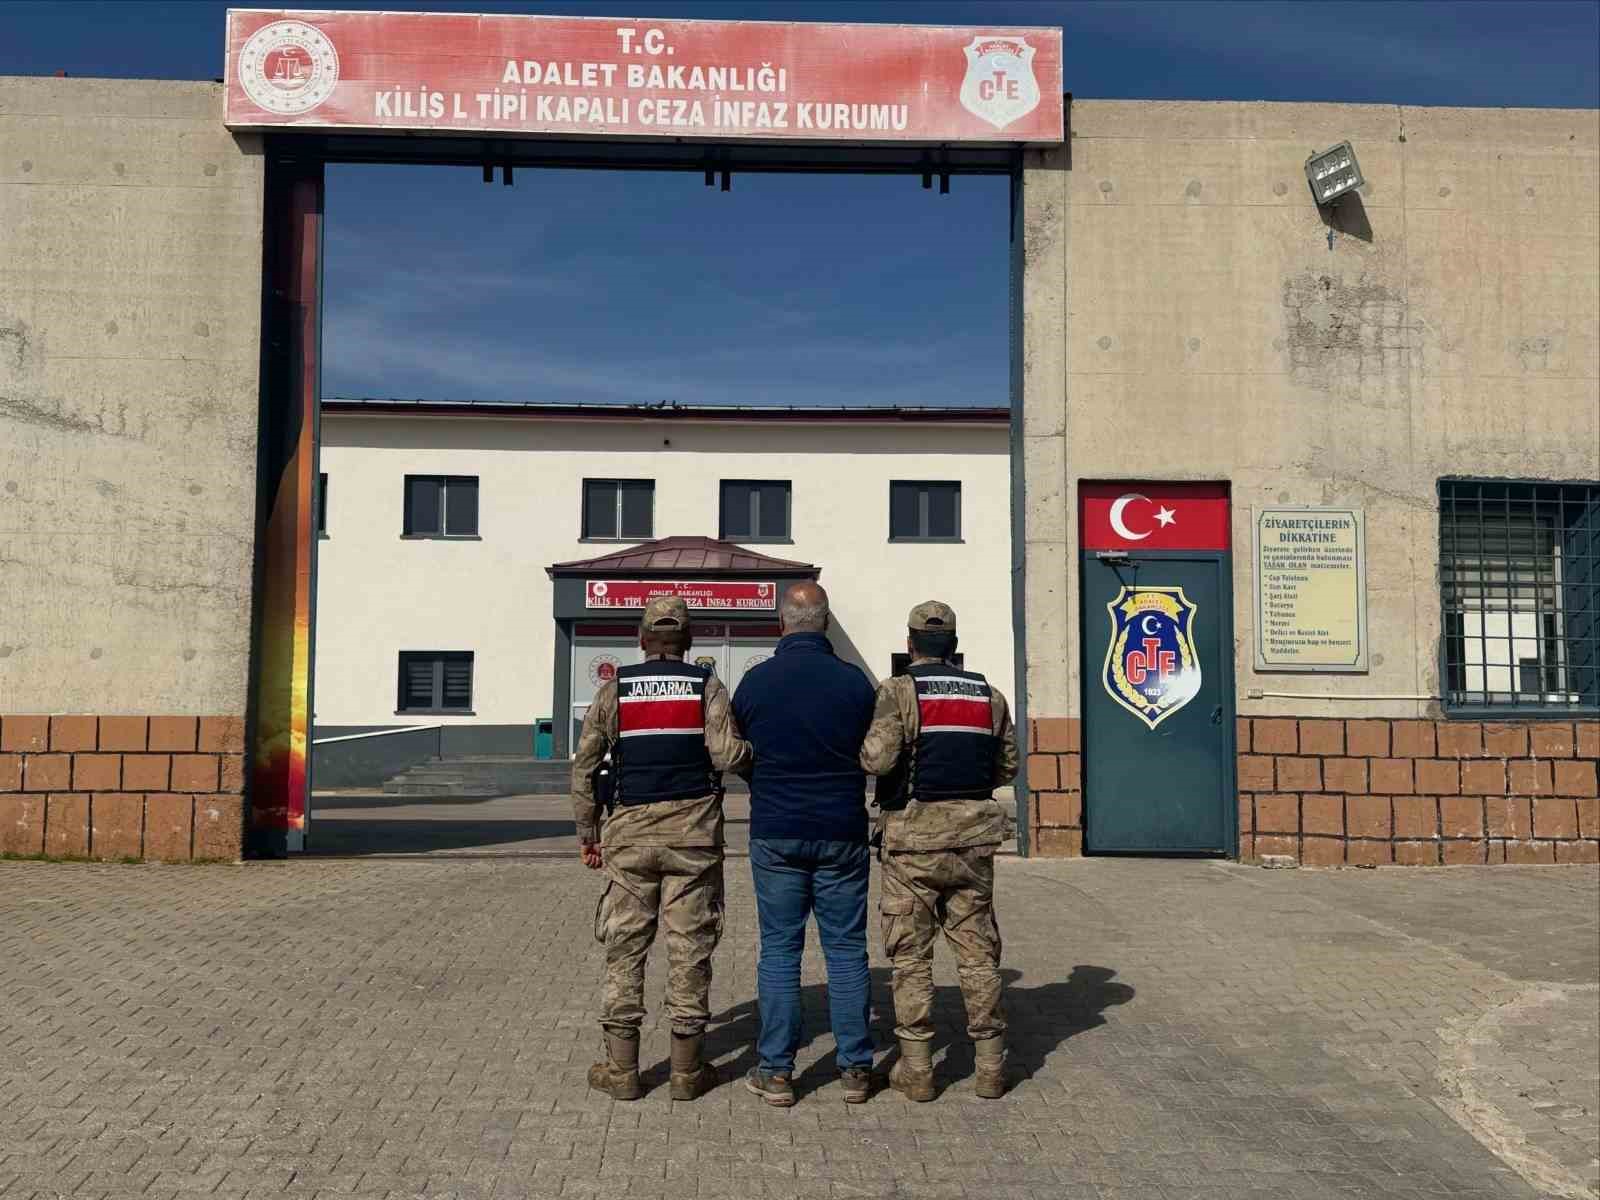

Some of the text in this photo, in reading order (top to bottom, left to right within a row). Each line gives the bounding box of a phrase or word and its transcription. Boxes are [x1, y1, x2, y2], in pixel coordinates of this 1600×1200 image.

[617, 28, 674, 55] T.C.
[503, 61, 787, 92] ADALET BAKANLIĞI
[375, 85, 908, 130] KİLİS L TİPİ KAPALI CEZA İNFAZ KURUMU
[629, 681, 694, 696] JANDARMA
